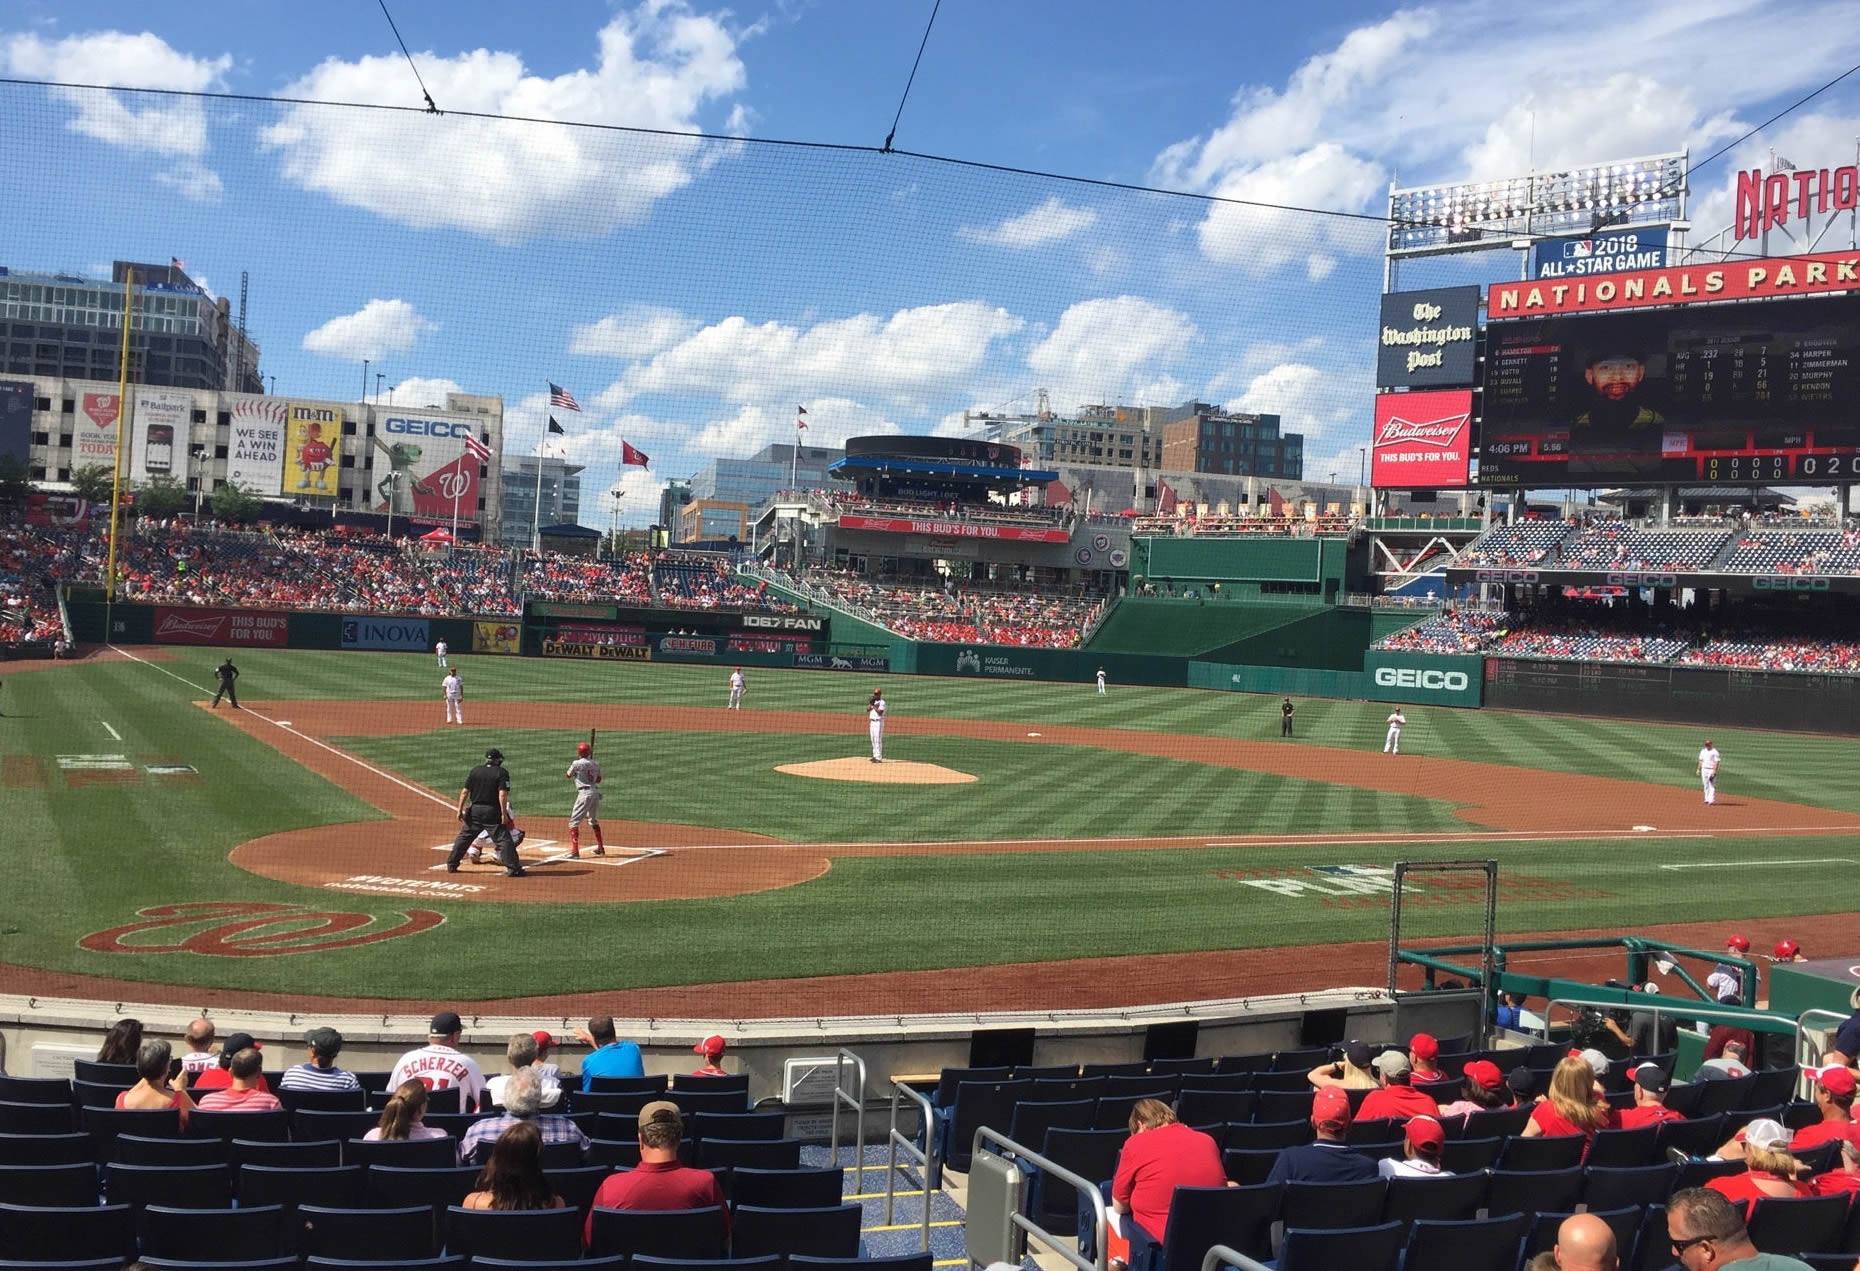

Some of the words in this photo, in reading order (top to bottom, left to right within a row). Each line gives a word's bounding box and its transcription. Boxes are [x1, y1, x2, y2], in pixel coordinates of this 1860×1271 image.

[1595, 234, 1638, 256] 2018
[1540, 260, 1566, 279] ALL
[1575, 255, 1613, 275] STAR
[1615, 250, 1661, 271] GAME
[1500, 270, 1724, 310] NATIONALS
[1748, 258, 1860, 289] PARK
[1412, 301, 1442, 322] The
[1381, 324, 1473, 349] Washington
[1406, 349, 1443, 373] Post
[1803, 350, 1832, 358] HARPER
[1802, 359, 1848, 368] ZIMMERMAN
[1801, 371, 1833, 380] MURPHY
[236, 428, 256, 439] WE
[258, 429, 278, 440] SEE
[385, 417, 472, 439] GEICO
[1381, 422, 1459, 440] Budweiser
[237, 440, 246, 450] A
[249, 440, 276, 451] WIN
[1512, 443, 1528, 453] PM
[234, 450, 277, 462] AHEAD
[1380, 452, 1398, 463] THIS
[1399, 452, 1423, 463] BUD'S
[1424, 451, 1441, 462] FOR
[1827, 457, 1840, 474] 2
[1481, 474, 1519, 483] NATIONALS
[911, 521, 931, 532] THIS
[933, 522, 961, 534] BUD'S
[961, 524, 979, 535] FOR
[1475, 570, 1539, 584] GEICO
[1606, 572, 1677, 588] GEICO
[1752, 575, 1830, 592] GEICO
[231, 616, 254, 628] THIS
[256, 617, 287, 629] BUD'S
[784, 618, 821, 630] FAN
[230, 628, 251, 639] FOR
[364, 624, 427, 643] INOVA
[798, 655, 823, 664] MGM
[860, 657, 885, 667] MGM
[984, 656, 1009, 665] KAISER
[1374, 667, 1468, 691] GEICO
[323, 882, 465, 899] nationals.com
[403, 1056, 469, 1082] SCHERZER
